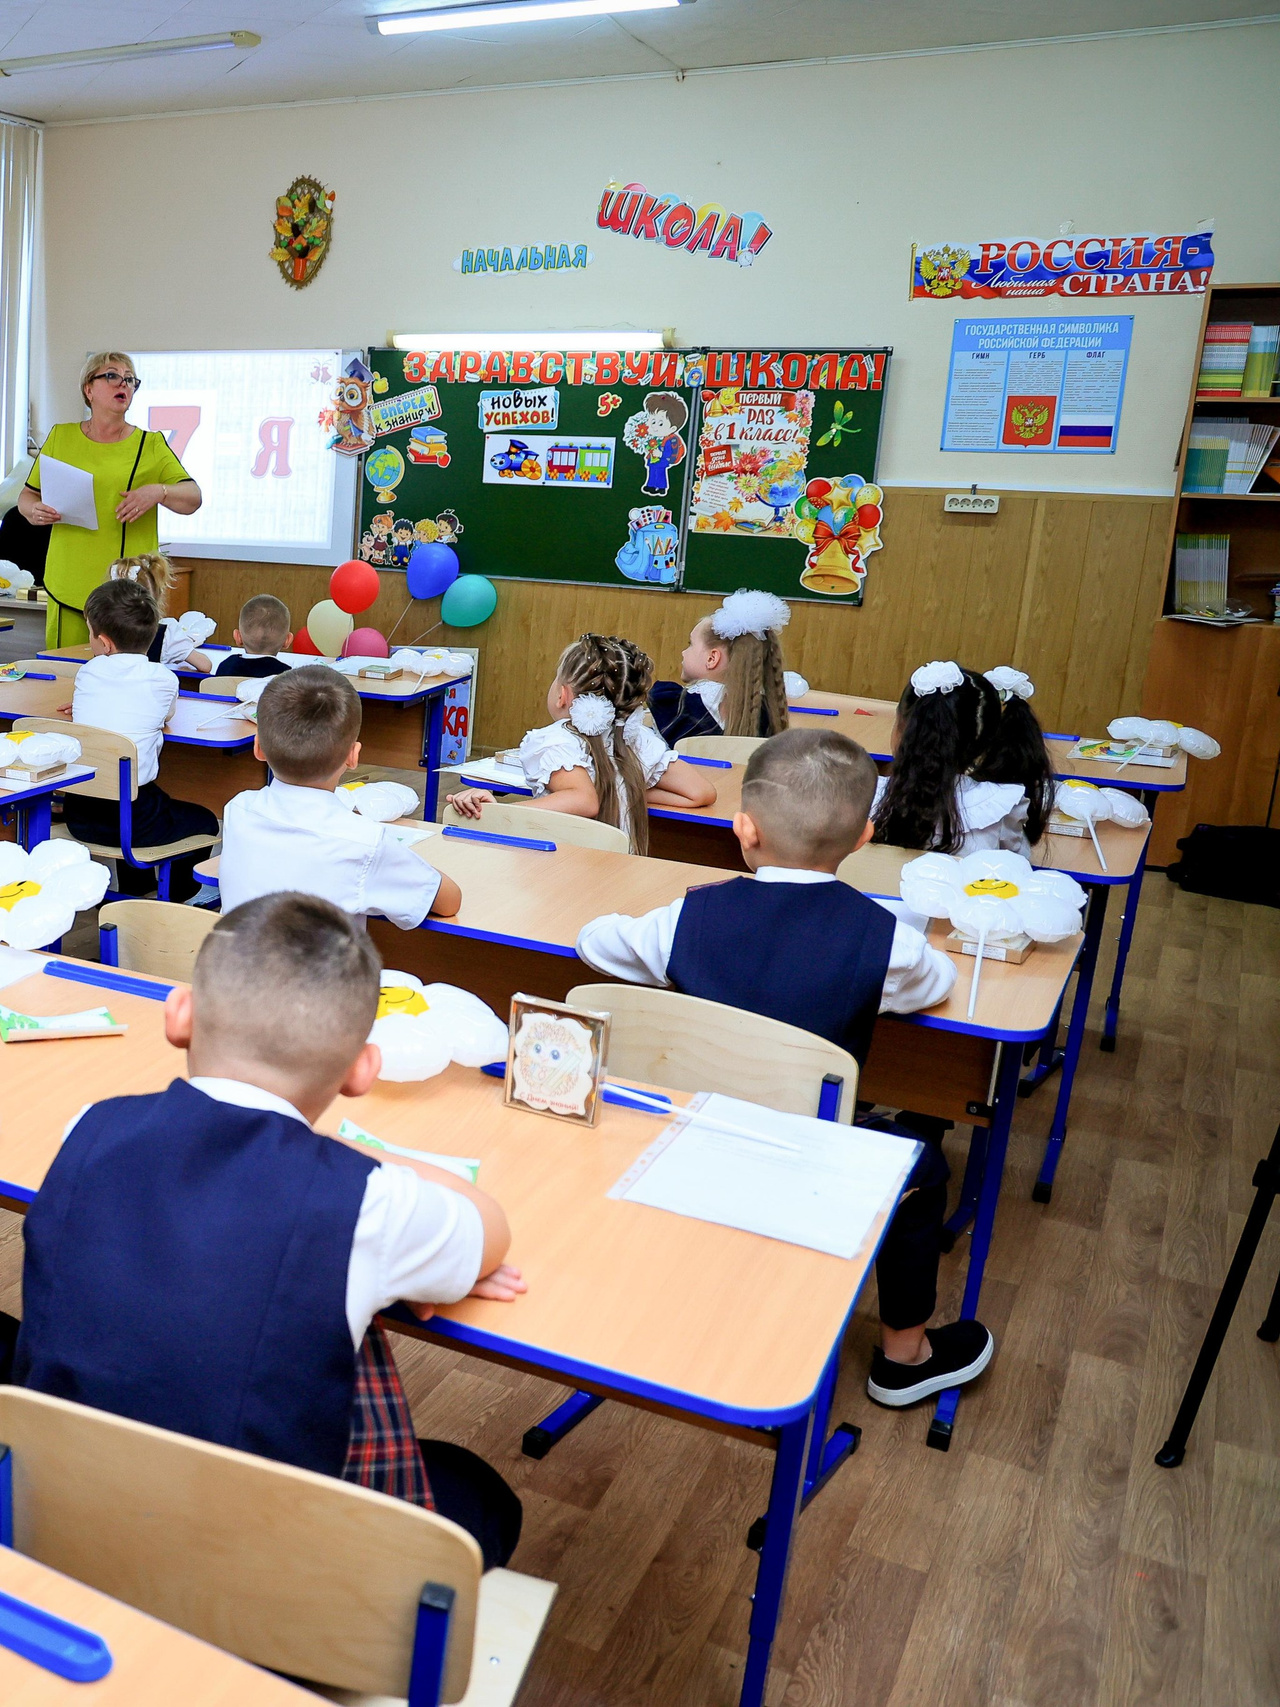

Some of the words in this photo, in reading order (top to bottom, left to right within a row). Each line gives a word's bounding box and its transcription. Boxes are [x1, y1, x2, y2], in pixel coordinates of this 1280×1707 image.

[596, 189, 774, 262] ШКОЛА!
[461, 244, 587, 274] НАЧАЛЬНАЯ
[971, 267, 1057, 289] Любимая
[1062, 271, 1208, 295] СТРАНА!
[1006, 288, 1046, 296] наша
[965, 323, 1055, 336] ГОСУДАРСТВЕННАЯ
[1058, 322, 1119, 335] СИМВОЛИКА
[978, 336, 1039, 349] РОССИЙСКОЙ
[1041, 336, 1102, 349] ФЕДЕРАЦИИ
[972, 352, 990, 360] ГИМН
[1086, 351, 1106, 359] ФЛАГ
[705, 352, 886, 390] ШКОЛА!
[598, 393, 621, 415] 5+
[739, 392, 782, 405] ПЕРВЫЙ
[484, 408, 554, 426] УСПЕХОВ!
[747, 408, 775, 425] РАЗ
[714, 422, 725, 440] в
[726, 422, 736, 439] 1
[148, 405, 201, 462] 7
[250, 416, 295, 479] Я
